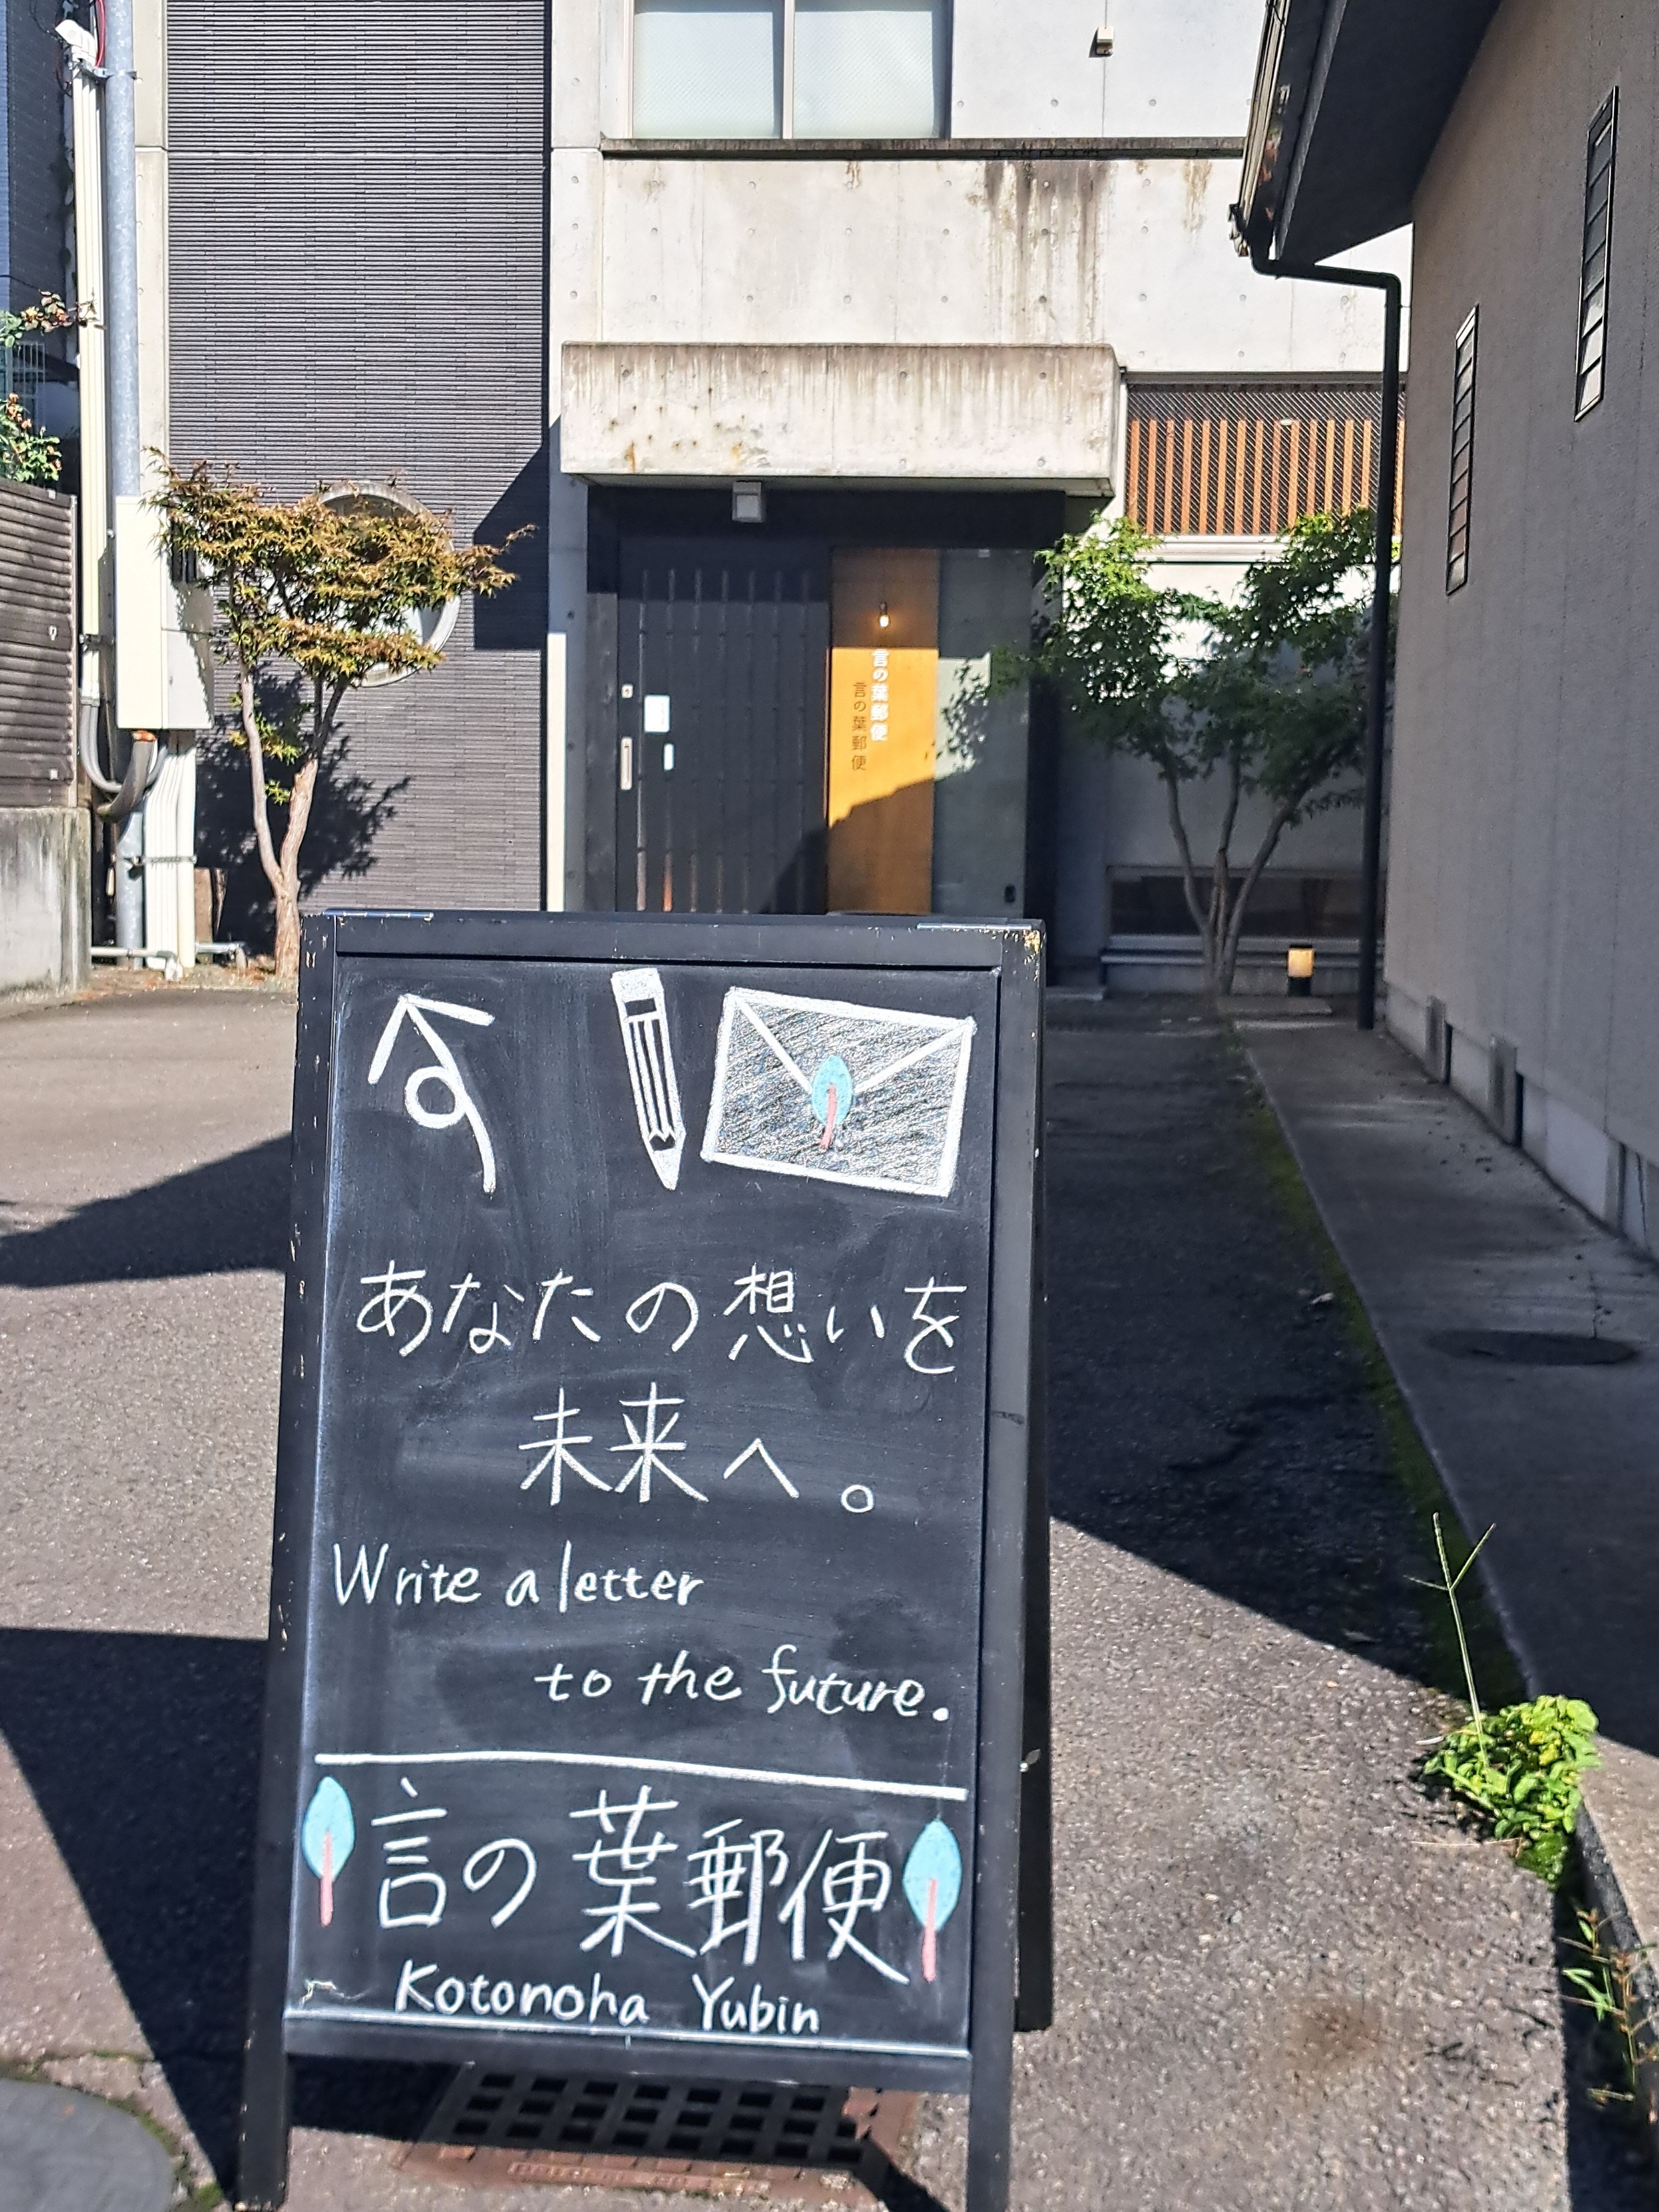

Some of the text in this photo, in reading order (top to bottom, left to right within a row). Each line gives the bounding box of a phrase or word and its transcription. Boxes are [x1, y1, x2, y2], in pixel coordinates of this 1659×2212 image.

[852, 683, 867, 771] 言の葉郵便
[871, 649, 888, 741] 言の葉郵便
[357, 1260, 966, 1373] あなたの想いを
[519, 1382, 874, 1513] 未来へ。
[334, 1540, 705, 1613] Write a letter
[534, 1645, 950, 1721] to the future.
[372, 1778, 910, 1984] 言の葉郵便
[394, 1959, 820, 2034] Kotonoha Yubin
